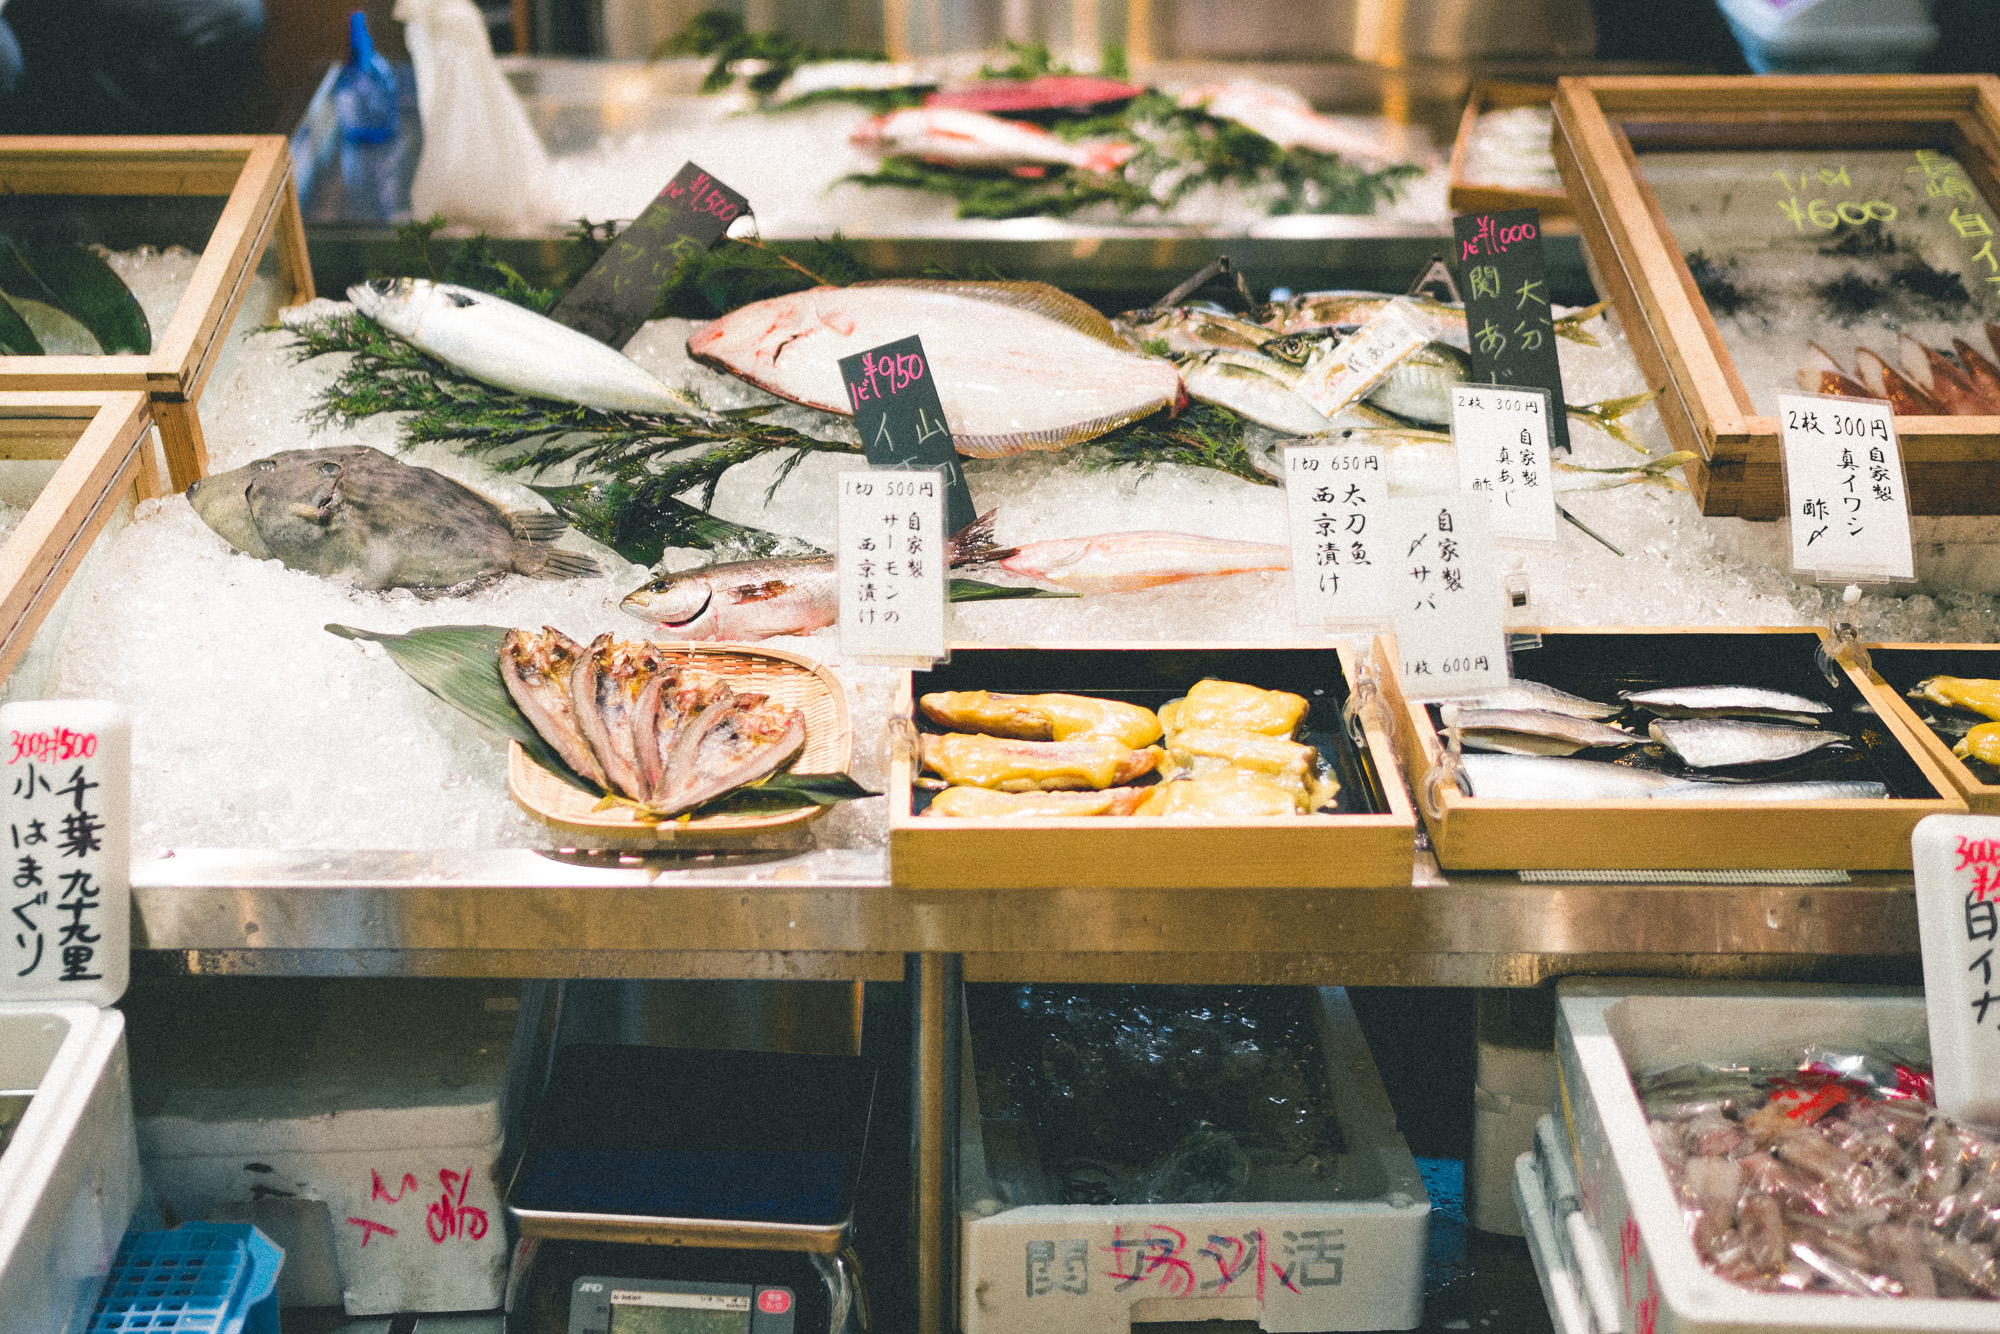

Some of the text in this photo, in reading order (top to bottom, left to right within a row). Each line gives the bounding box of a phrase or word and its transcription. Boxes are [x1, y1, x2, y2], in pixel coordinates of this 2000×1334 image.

[1477, 215, 1536, 256] ¥1,000
[1777, 196, 1898, 230] ¥600
[1513, 278, 1551, 351] 大分
[862, 352, 924, 400] ¥950
[1458, 395, 1538, 415] 2枚 300円
[1788, 410, 1889, 442] 2枚 300円
[1291, 455, 1379, 472] 1切 650円
[1495, 445, 1515, 508] 真あじ
[1519, 428, 1540, 488] 自家製
[1869, 446, 1895, 502] 自家製
[845, 481, 934, 498] 1切 500円
[1472, 477, 1494, 503] 酢
[1836, 447, 1864, 537] 真イワシ
[906, 511, 924, 579] 自家製
[1311, 486, 1341, 596] 西京漬け
[1341, 483, 1372, 566] 太刀魚
[1437, 508, 1465, 593] 自家製
[1802, 497, 1830, 547] 酢〆
[857, 537, 877, 626] 西京漬け
[881, 513, 899, 625] サーモンの
[1406, 532, 1436, 611] 〆サバ
[1404, 655, 1490, 677] 1枚 600円
[11, 762, 52, 978] 小はまぐり
[54, 764, 106, 983] 千葉九十九里
